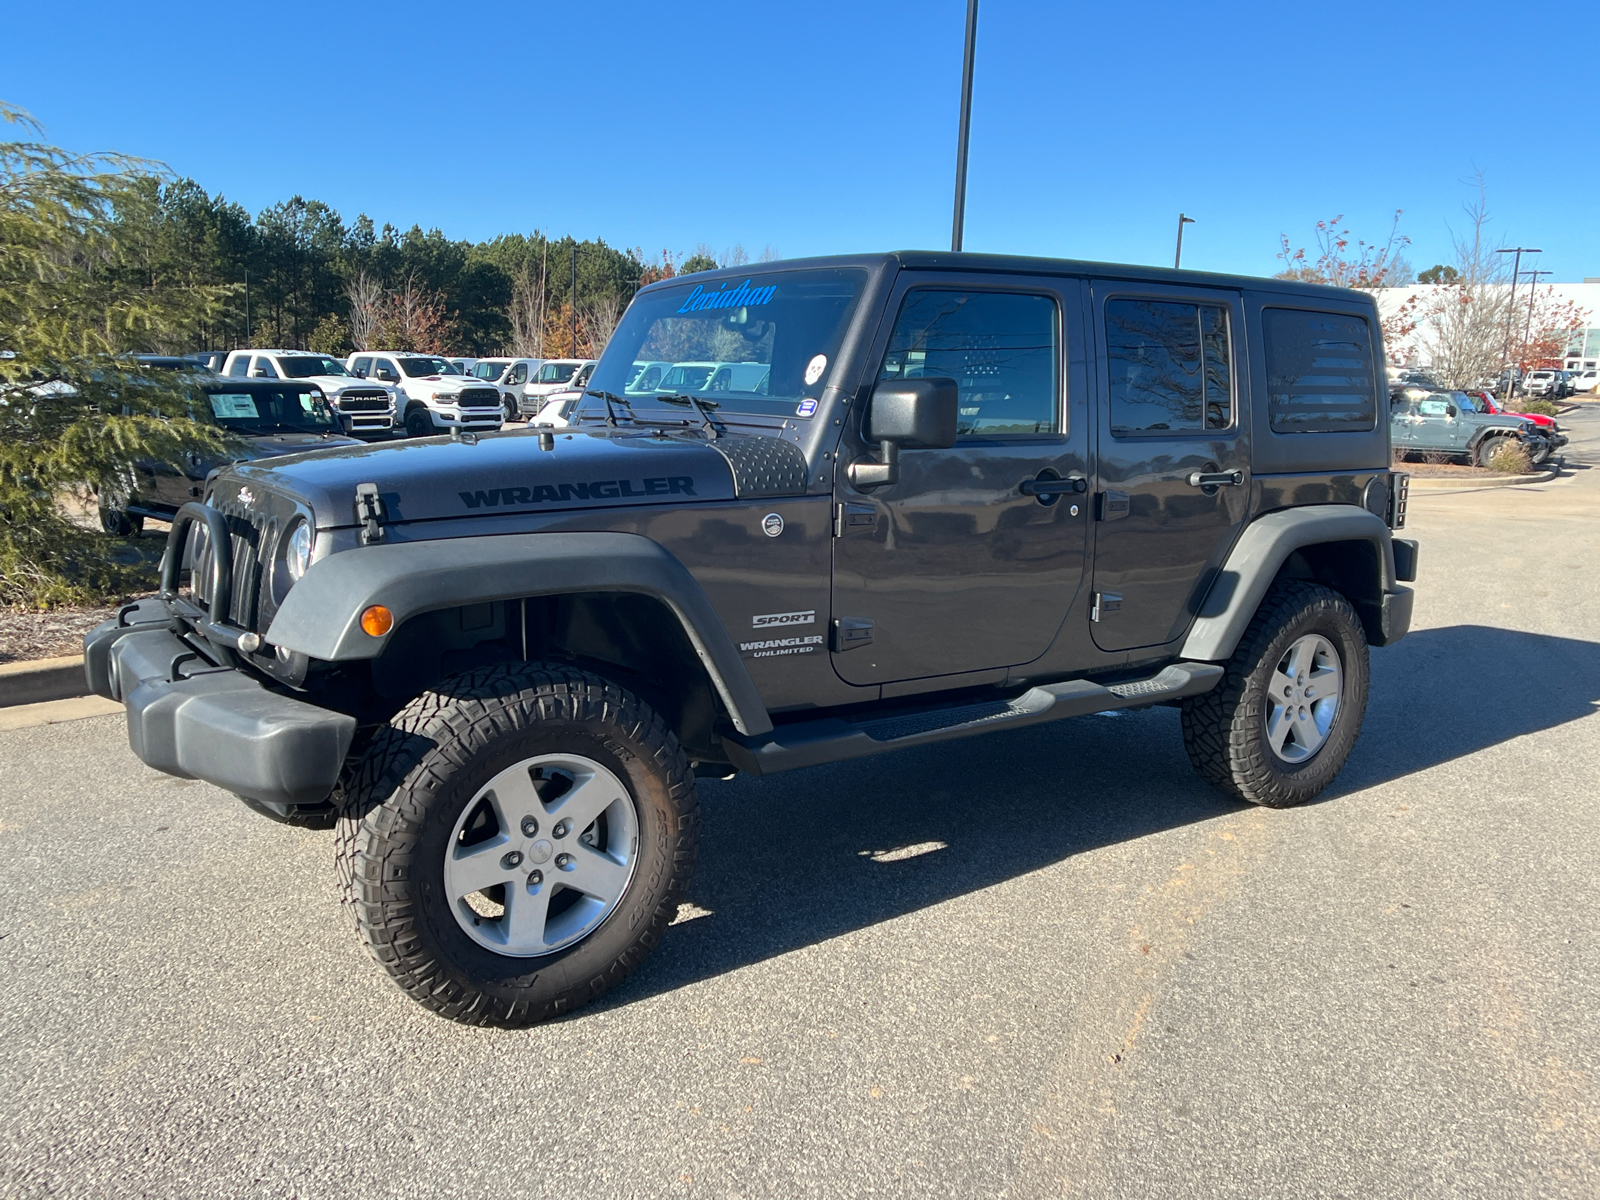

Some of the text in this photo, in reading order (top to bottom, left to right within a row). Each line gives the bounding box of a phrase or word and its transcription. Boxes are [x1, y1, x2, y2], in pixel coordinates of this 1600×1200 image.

[676, 279, 777, 314] Leviathan
[458, 475, 698, 509] WRANGLER
[755, 613, 812, 626] SPORT
[740, 635, 823, 651] WRANGLER
[753, 646, 814, 658] UNLIMITED
